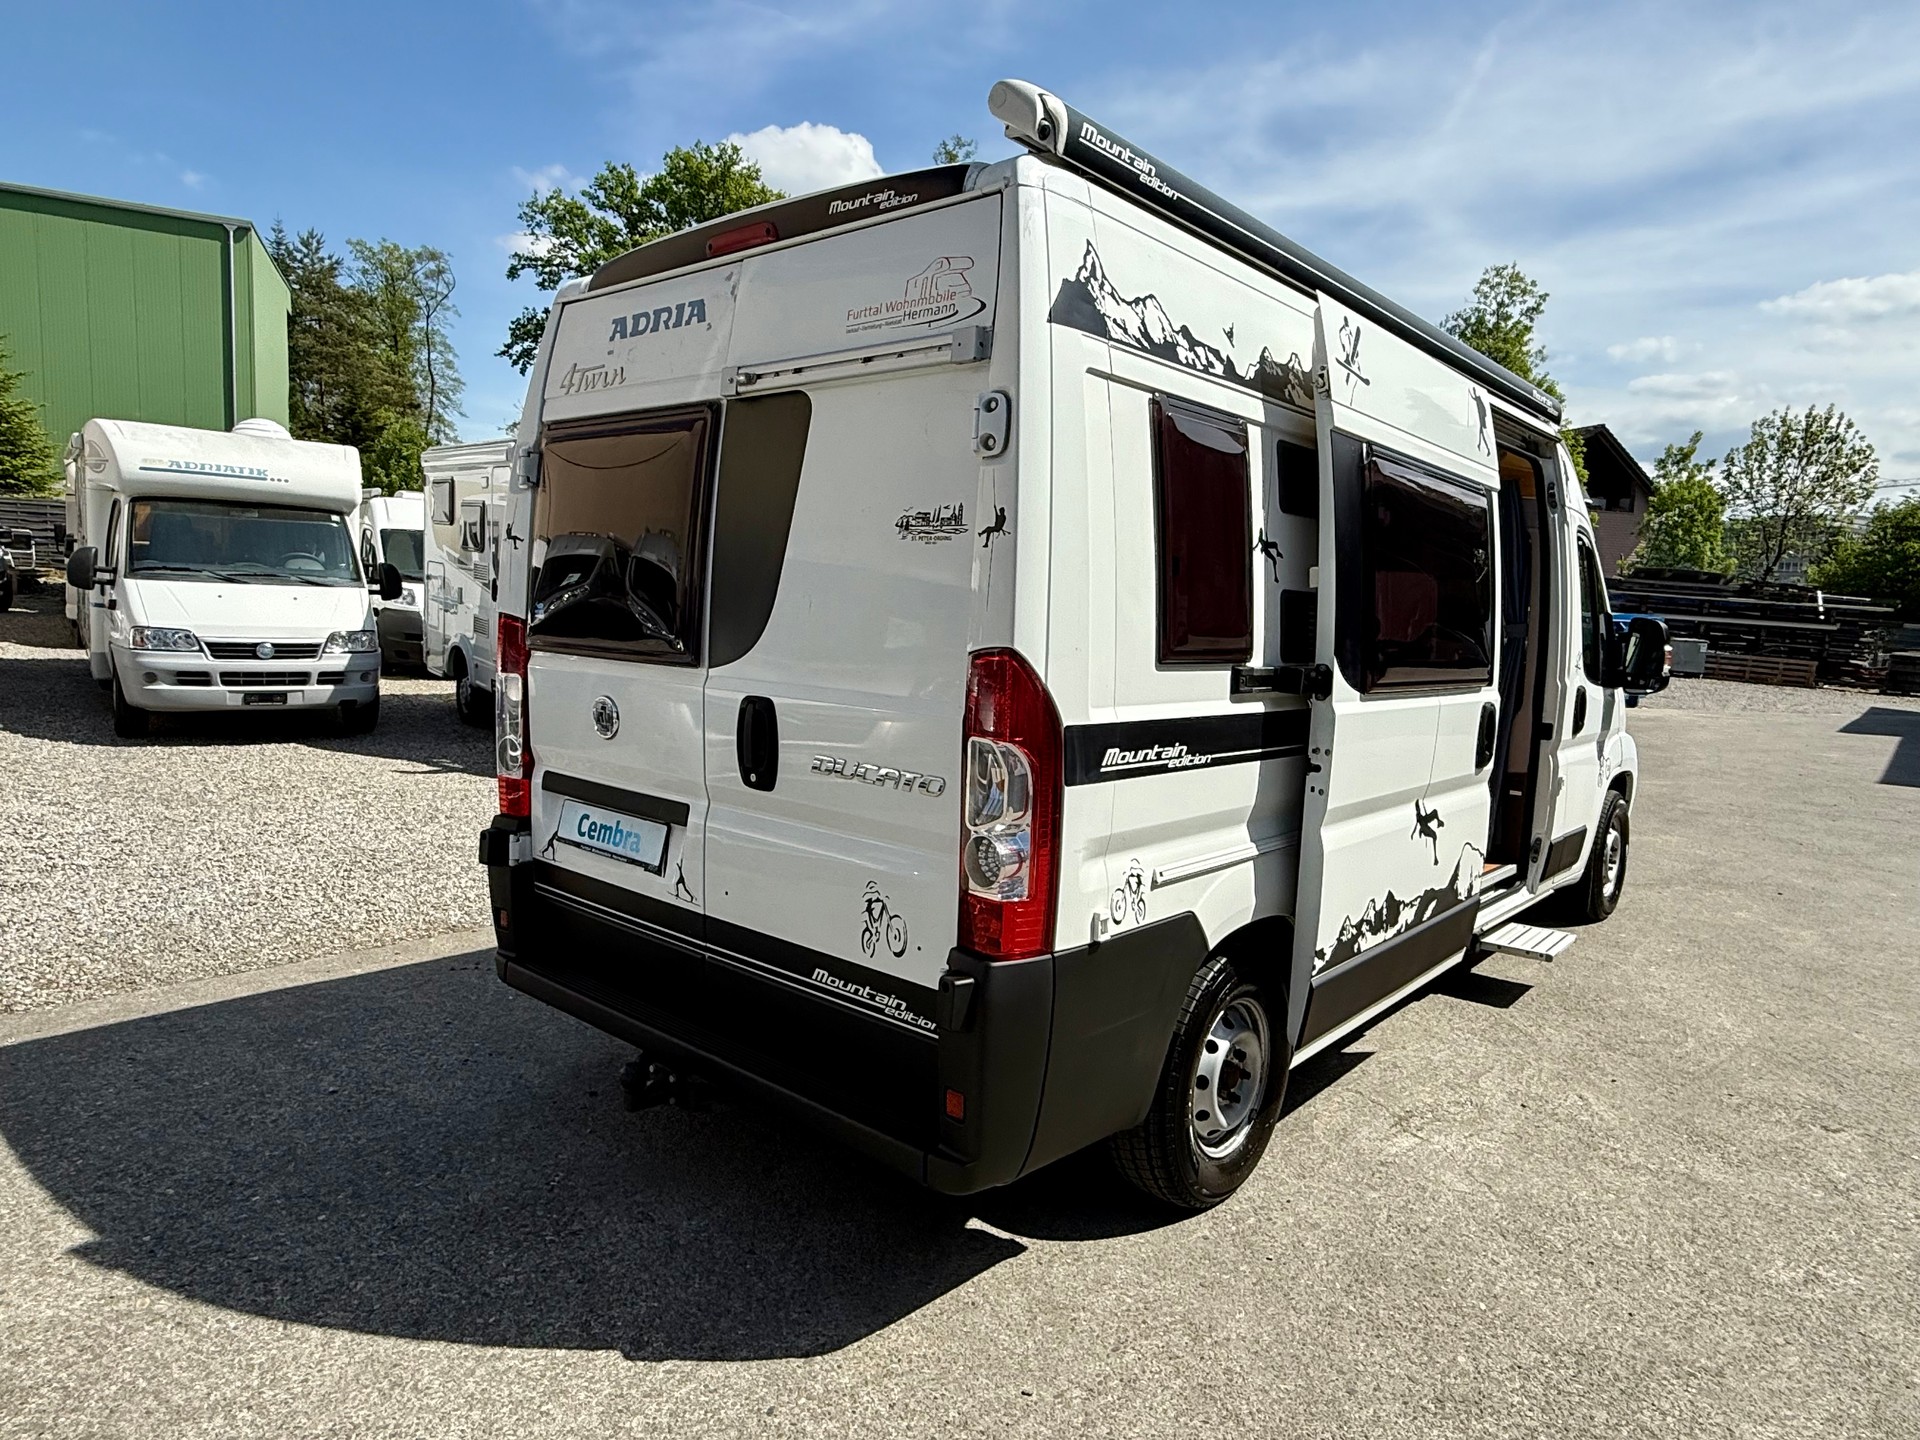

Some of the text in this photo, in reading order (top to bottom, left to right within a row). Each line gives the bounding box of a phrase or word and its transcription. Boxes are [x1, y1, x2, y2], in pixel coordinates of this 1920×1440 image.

[1081, 121, 1156, 177] Mountain
[1140, 172, 1179, 200] edition
[829, 188, 895, 215] Mountain
[879, 193, 918, 210] edition
[847, 289, 957, 321] Furttal Wohnmobile
[903, 302, 956, 321] Hermann
[609, 299, 706, 342] ADRIA
[168, 460, 269, 477] ADRIATIK
[1101, 742, 1188, 767] Mountain
[1168, 753, 1212, 768] edition
[811, 754, 946, 798] DUCATO
[577, 813, 641, 853] Cembra
[811, 967, 907, 1011] Mountain
